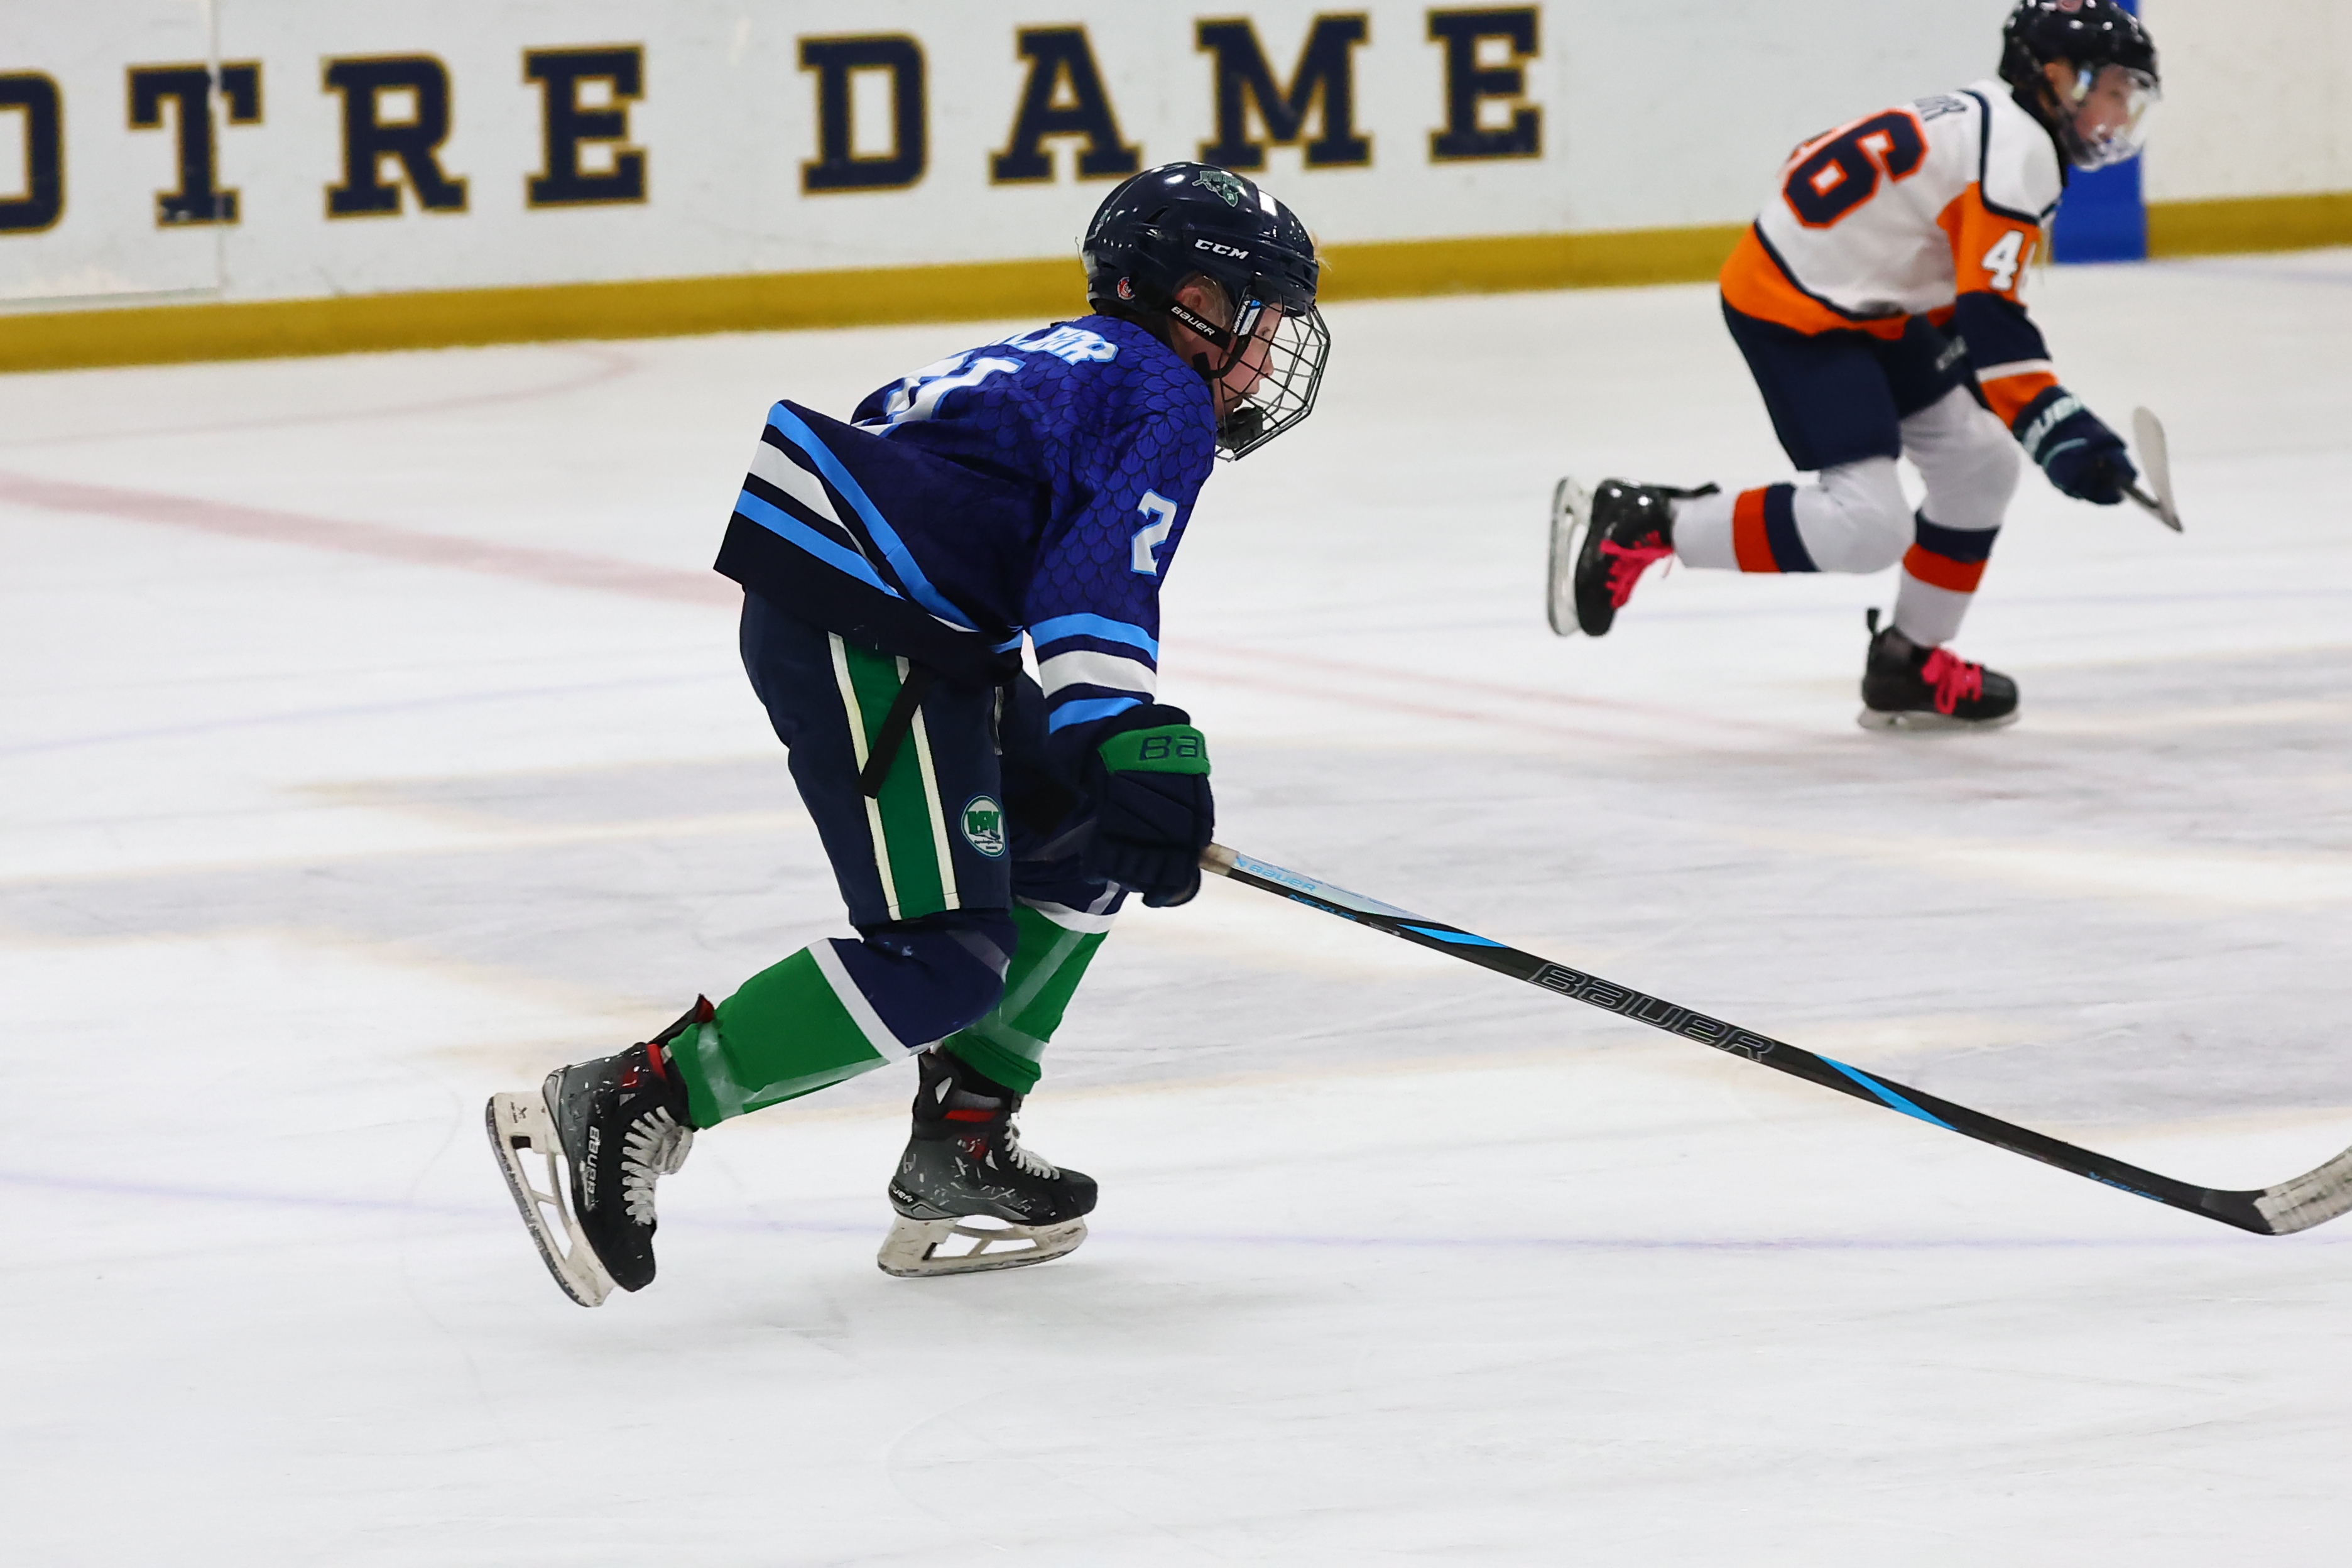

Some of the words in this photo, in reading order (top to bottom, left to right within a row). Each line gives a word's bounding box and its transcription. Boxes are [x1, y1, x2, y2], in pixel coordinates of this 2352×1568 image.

[797, 5, 1544, 196] DAME
[1783, 108, 1930, 230] 6
[1194, 239, 1250, 259] CCM
[1981, 229, 2034, 299] 4
[1170, 306, 1216, 336] BAUER
[1527, 963, 1775, 1063] BAUER
